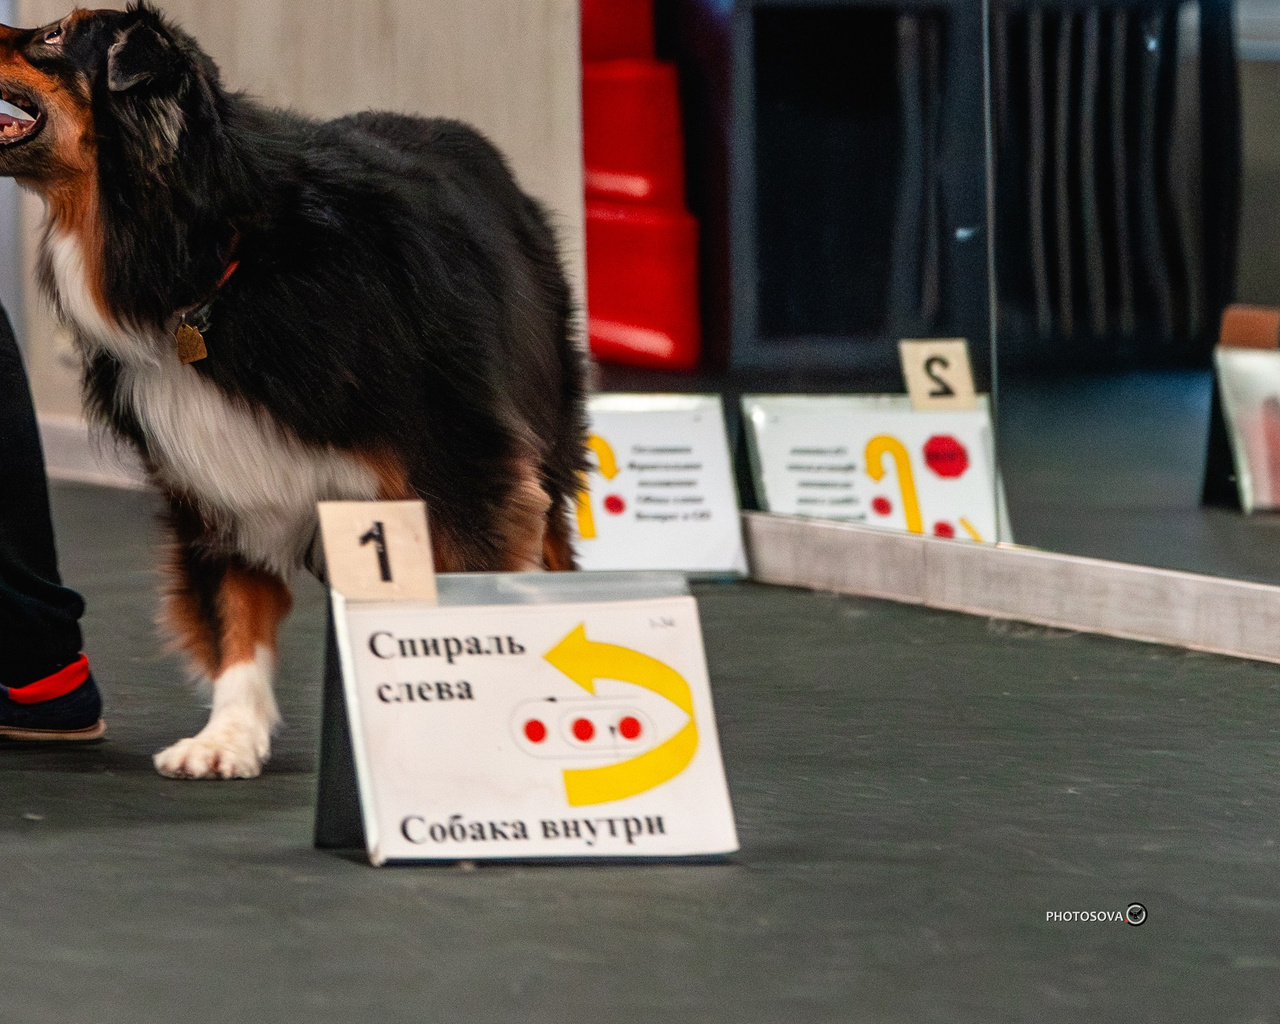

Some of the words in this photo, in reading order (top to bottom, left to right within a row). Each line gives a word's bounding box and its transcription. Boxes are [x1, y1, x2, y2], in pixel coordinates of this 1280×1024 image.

[359, 521, 393, 583] 1
[368, 630, 526, 664] Спираль
[376, 680, 475, 704] слева
[399, 813, 529, 844] Собака
[540, 814, 667, 846] внутри
